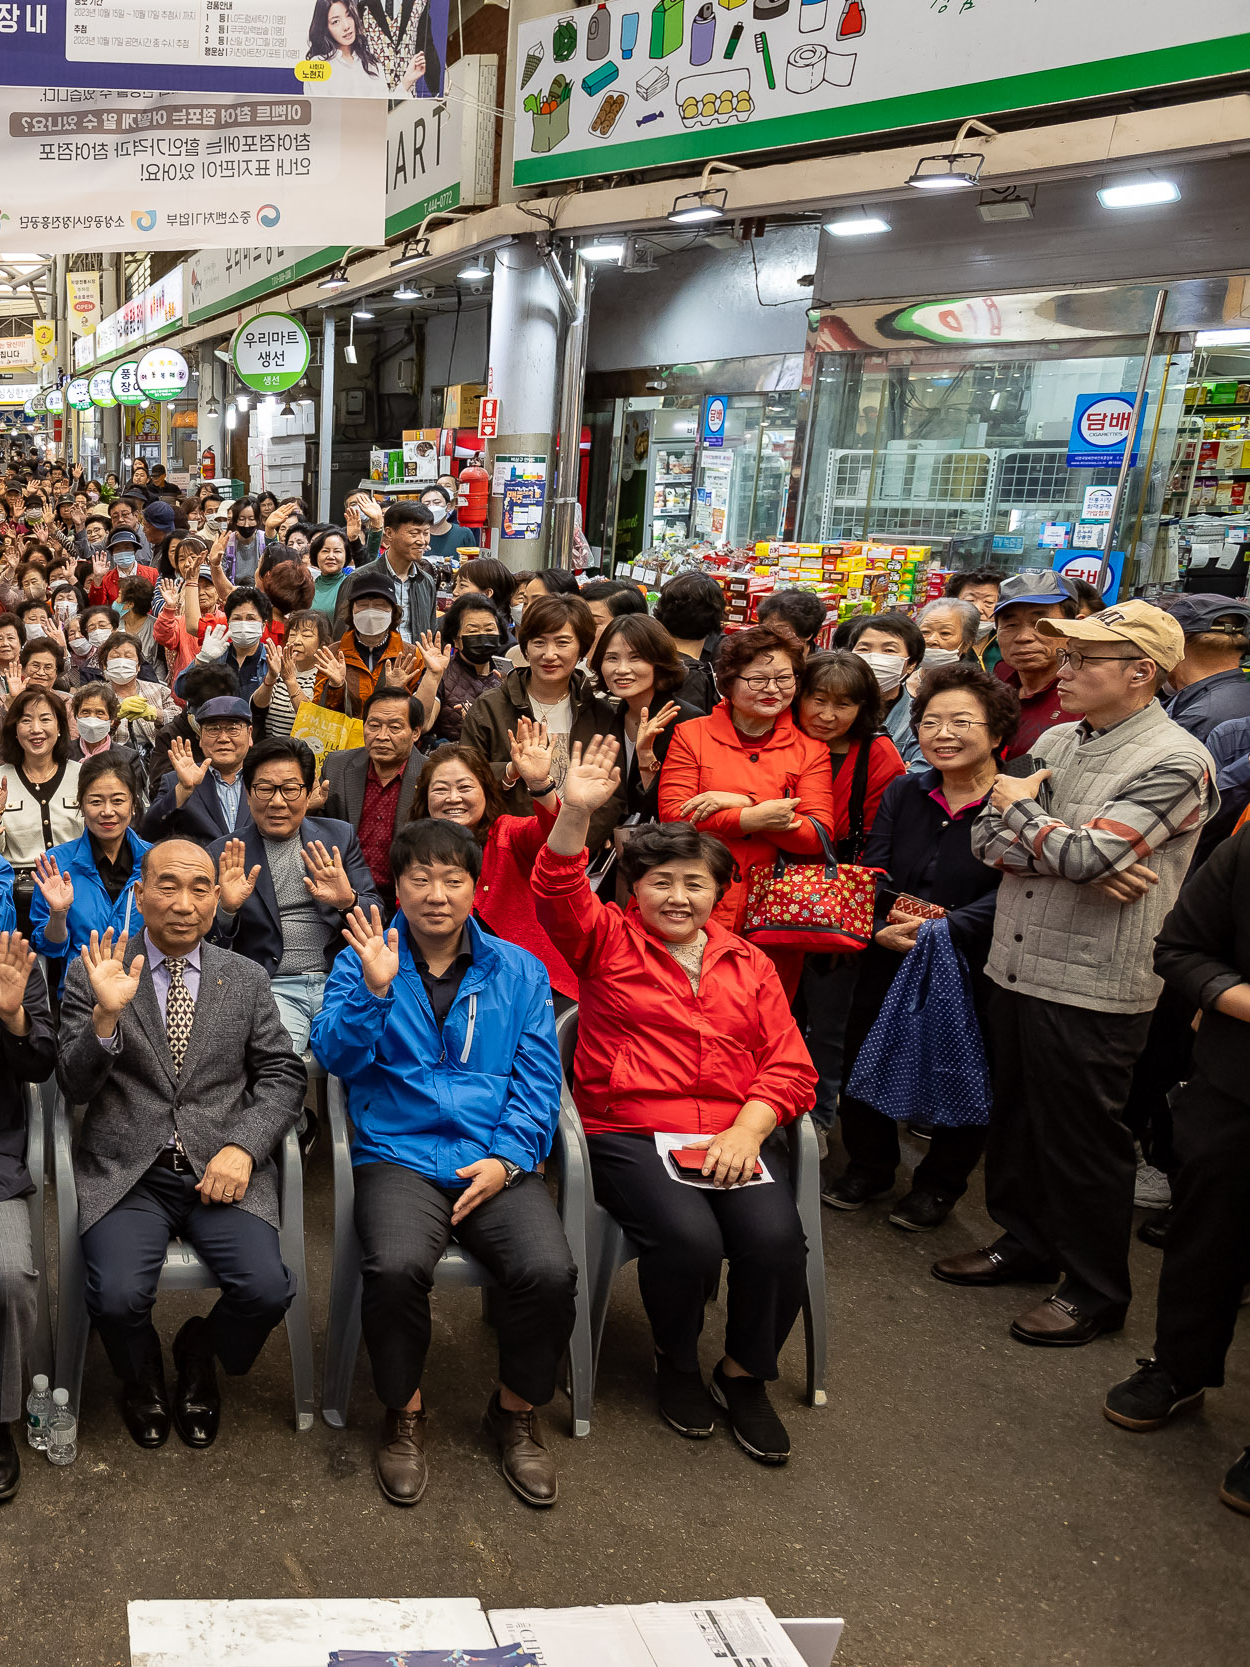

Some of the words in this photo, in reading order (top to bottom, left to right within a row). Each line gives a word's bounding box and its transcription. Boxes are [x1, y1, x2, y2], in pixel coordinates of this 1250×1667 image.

[25, 3, 48, 34] 내
[74, 8, 96, 18] 2023년
[182, 11, 196, 20] 까지
[74, 25, 88, 34] 추첨
[73, 36, 96, 46] 2023년
[125, 38, 152, 48] 공연시간
[301, 70, 325, 79] 노현지
[423, 191, 453, 215] T.444-0772
[243, 331, 300, 348] 우리마트
[257, 351, 286, 369] 생선
[262, 376, 281, 386] 생선
[1086, 412, 1132, 432] 담배
